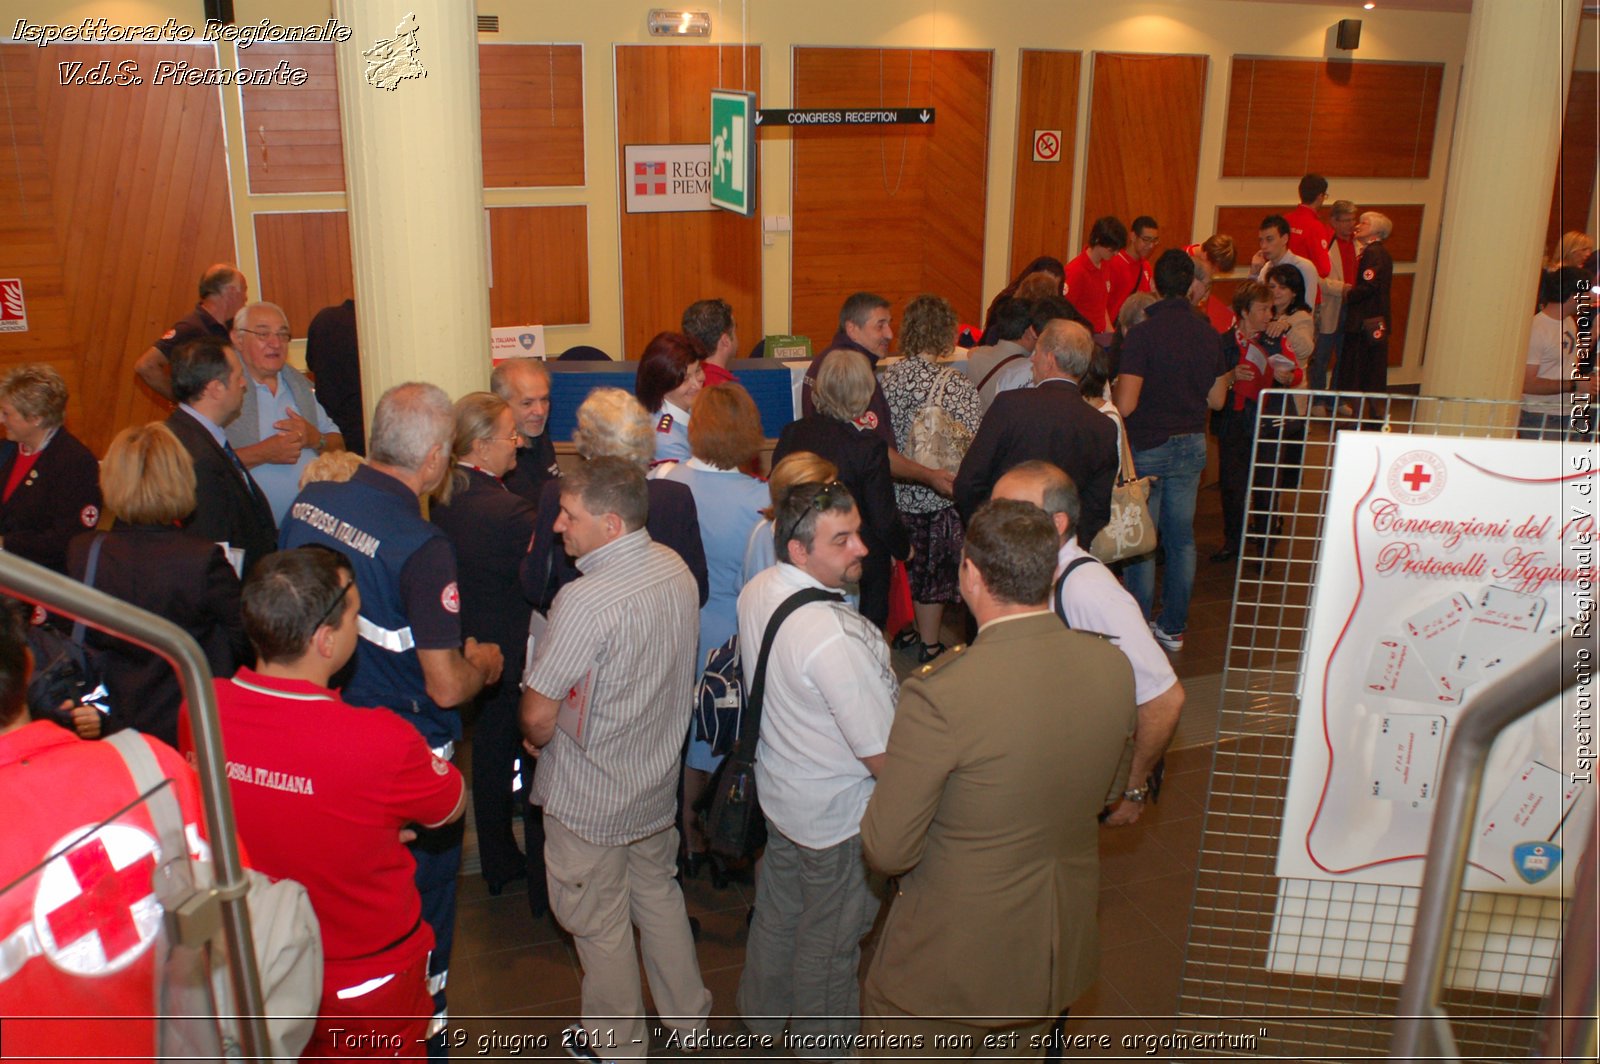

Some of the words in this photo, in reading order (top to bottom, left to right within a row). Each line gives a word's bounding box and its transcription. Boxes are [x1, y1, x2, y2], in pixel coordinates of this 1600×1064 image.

[787, 112, 842, 124] CONGRESS
[845, 111, 898, 123] RECEPTION
[306, 506, 340, 537] ROSSA
[334, 520, 381, 559] ITALIANA
[1369, 498, 1510, 548] Convenzioni
[1513, 514, 1552, 540] del
[1375, 541, 1488, 577] Protocolli
[254, 767, 315, 796] ITALIANA
